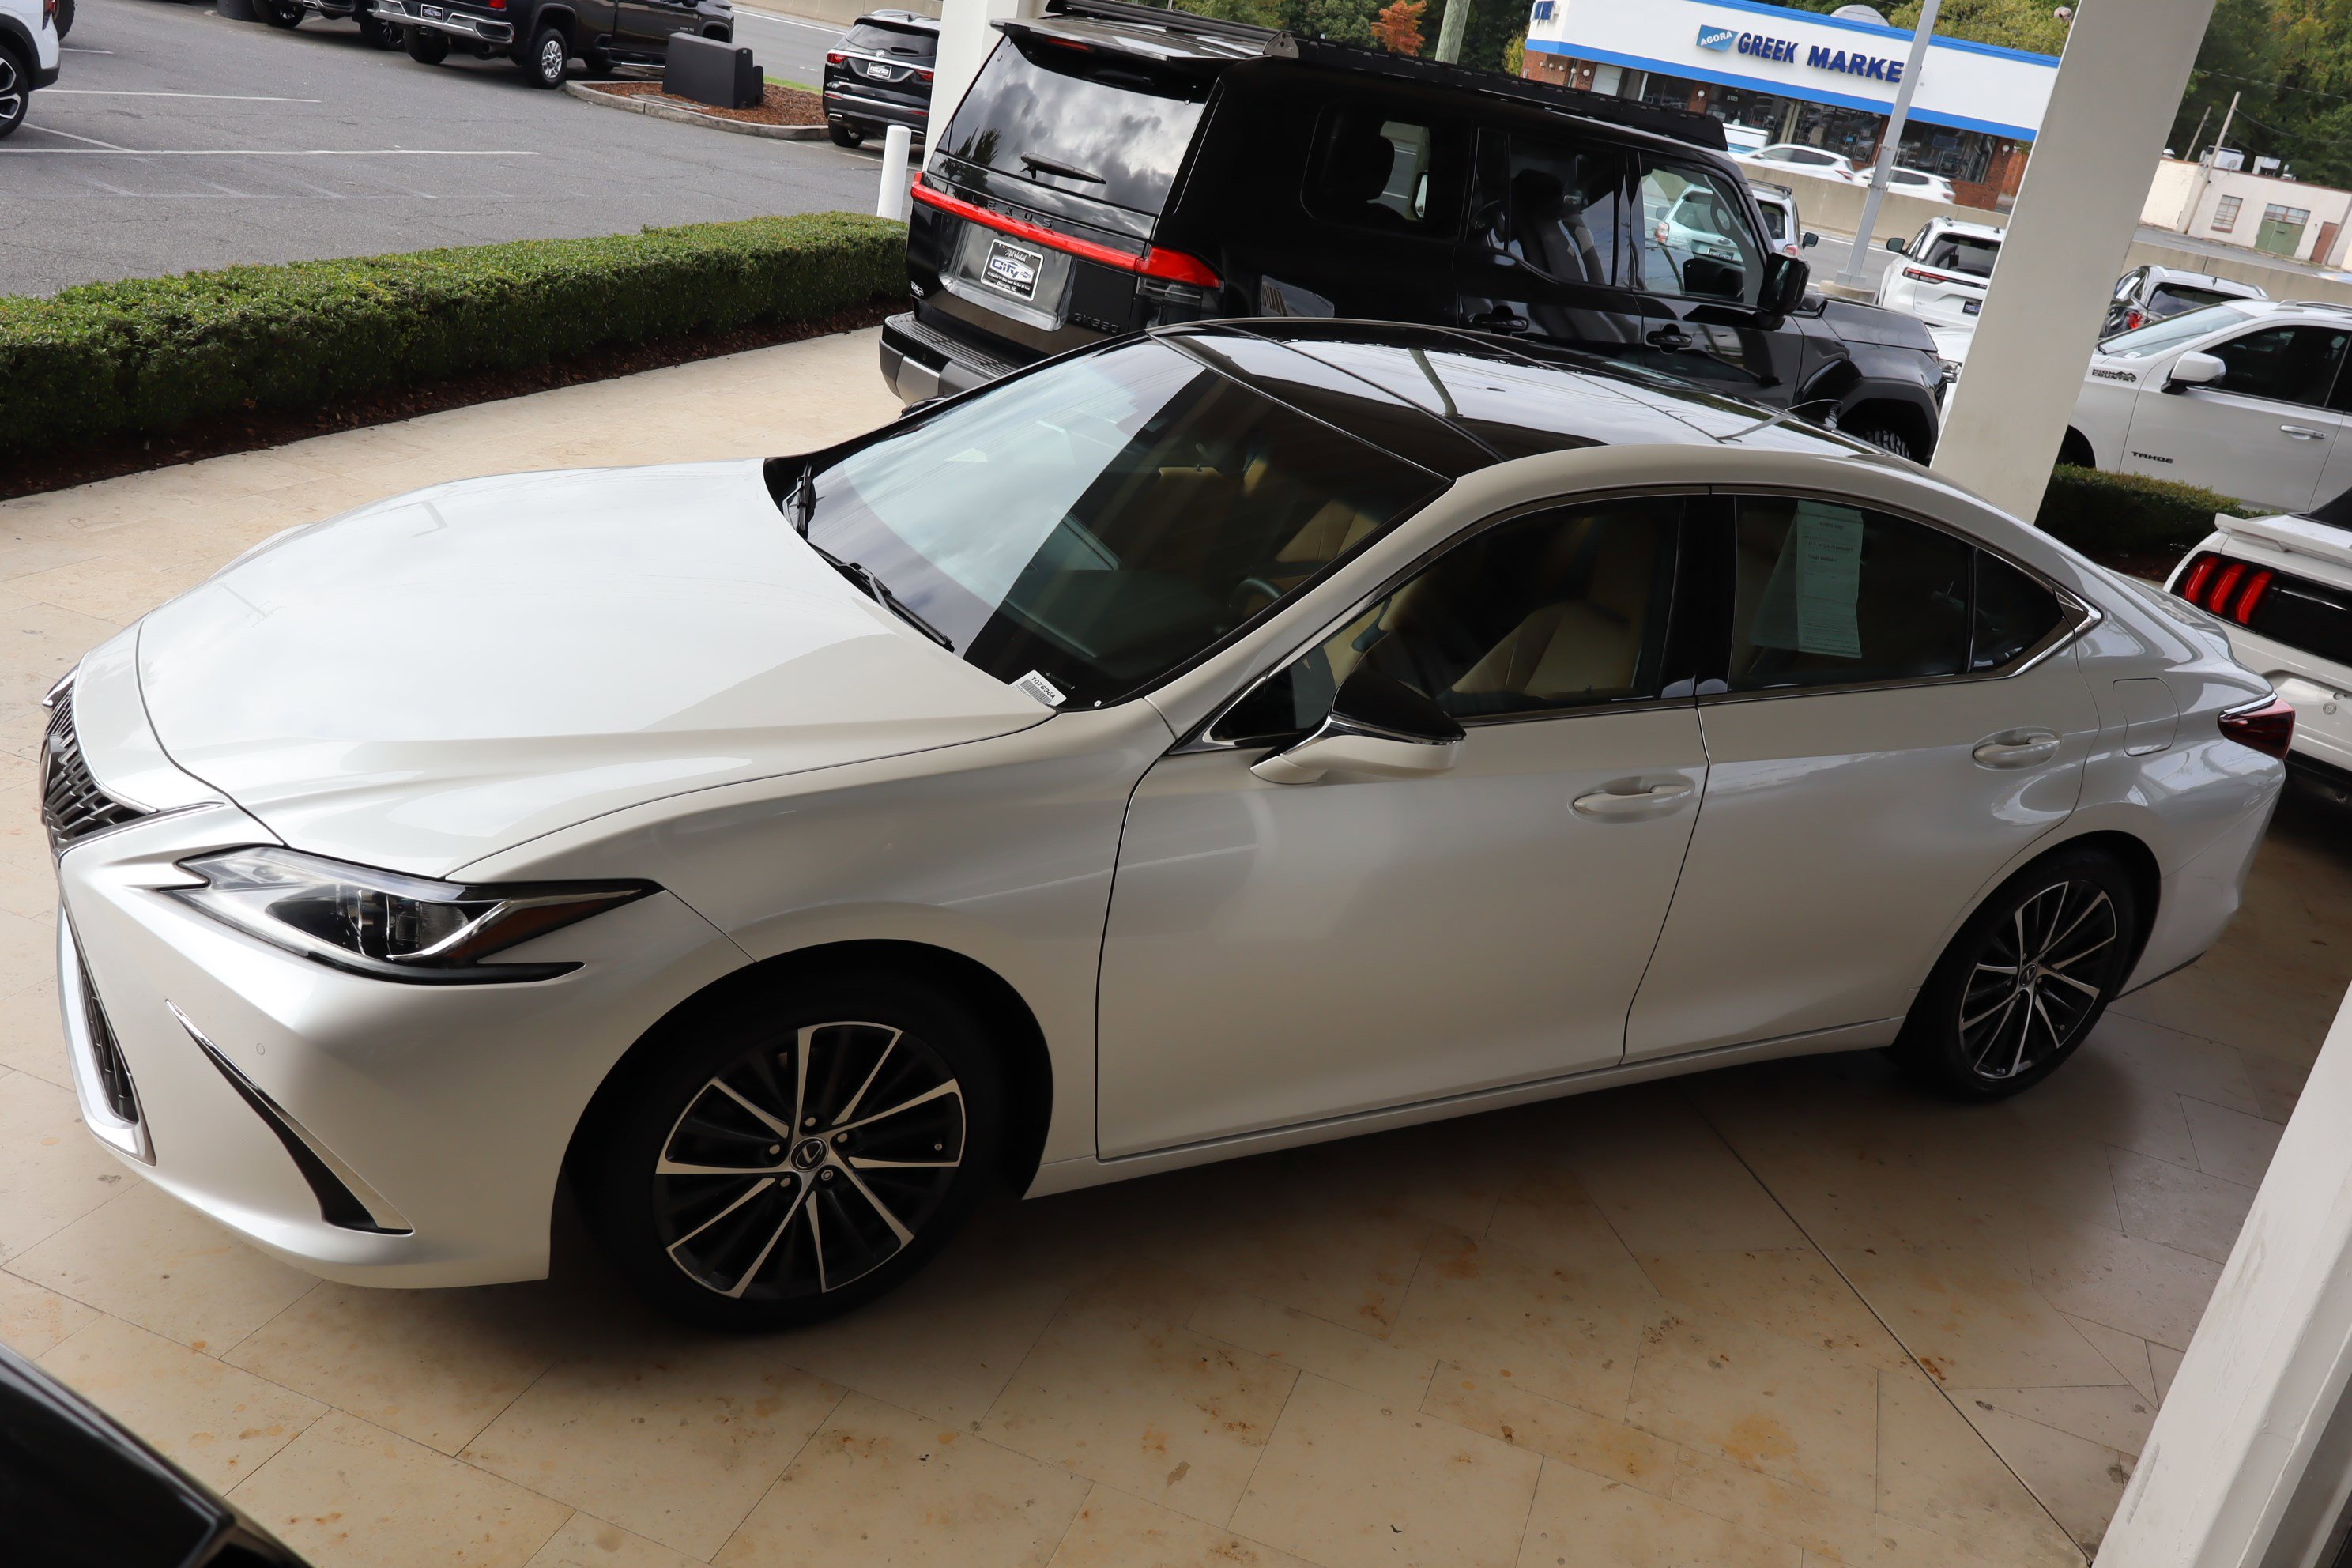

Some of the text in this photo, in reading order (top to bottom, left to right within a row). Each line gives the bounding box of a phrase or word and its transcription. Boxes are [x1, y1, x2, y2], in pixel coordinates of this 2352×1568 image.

[1700, 31, 1733, 46] AGORA
[1738, 32, 1922, 84] GREEK MARKE
[971, 195, 1053, 228] LEXUS
[991, 258, 1020, 278] City
[2132, 451, 2173, 464] TAHOE
[1031, 676, 1056, 699] T07696A
